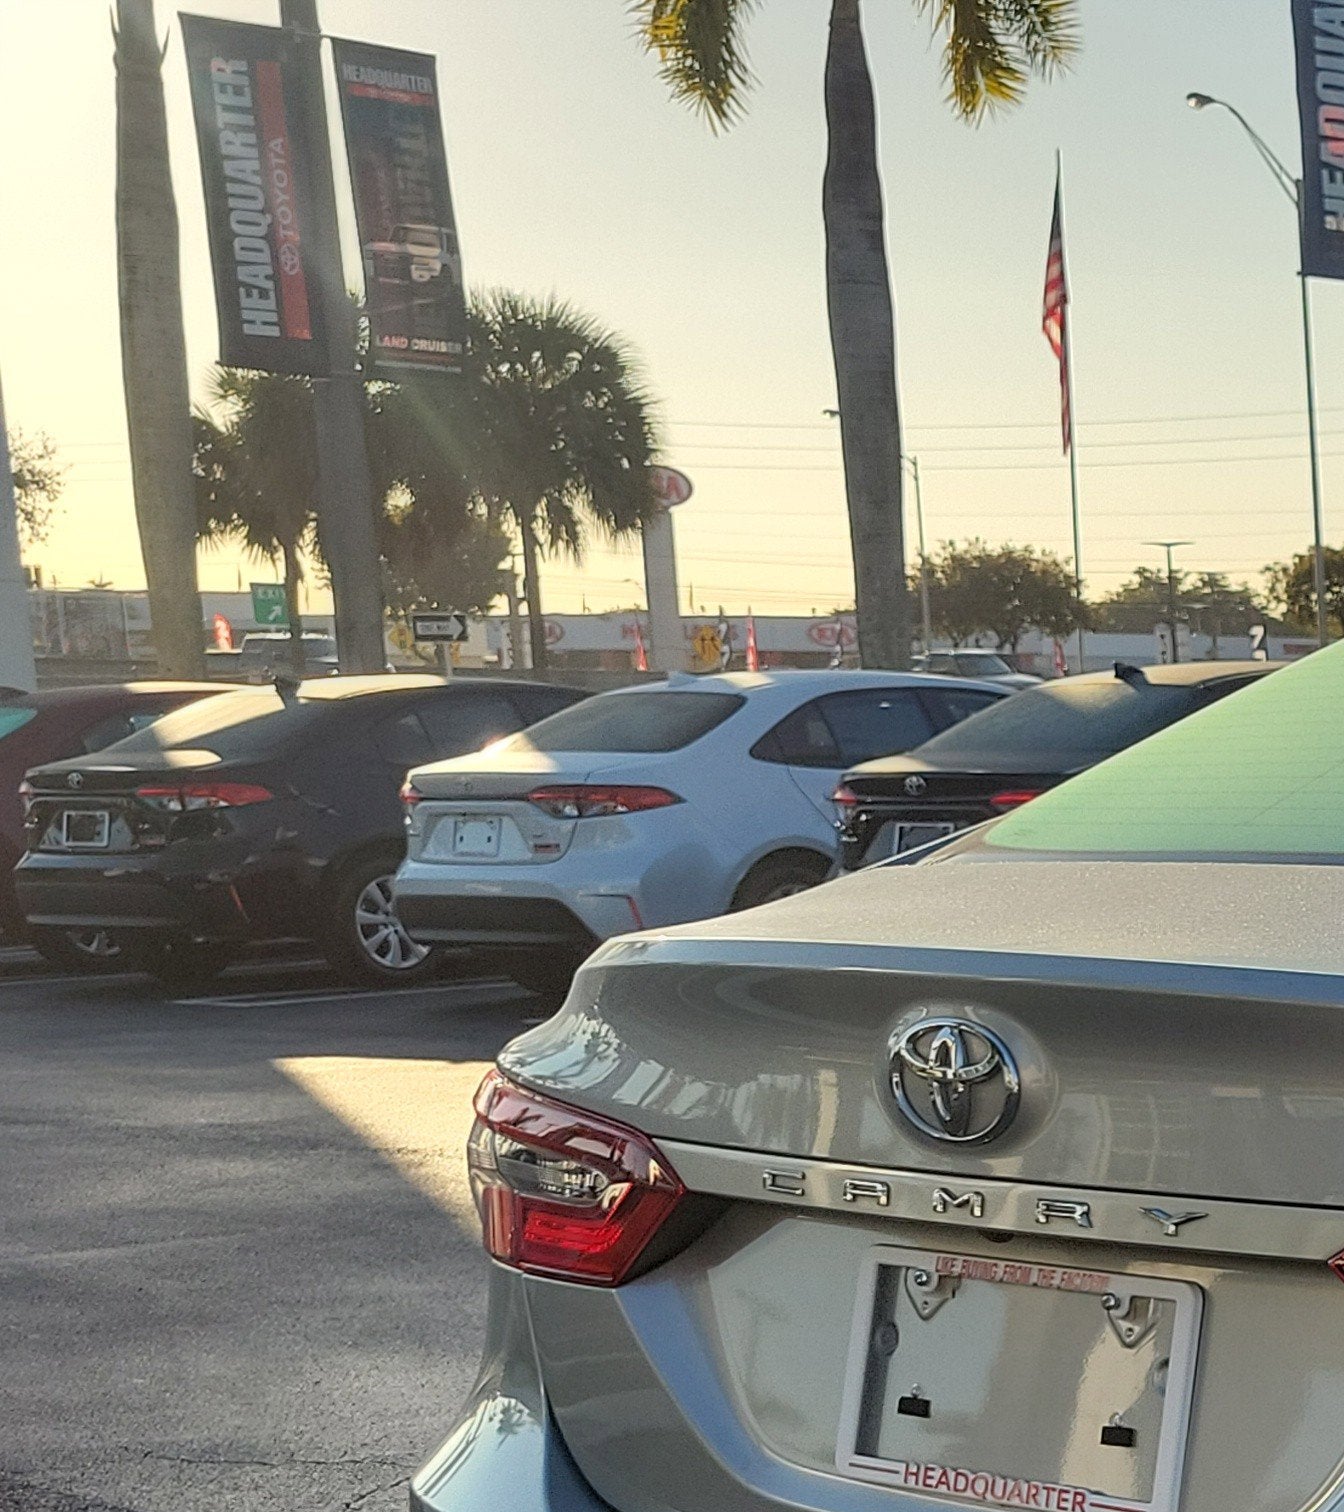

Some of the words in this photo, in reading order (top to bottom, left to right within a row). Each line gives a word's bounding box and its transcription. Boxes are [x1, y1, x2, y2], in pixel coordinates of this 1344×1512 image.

[210, 57, 282, 338] HEADQUARTER
[267, 137, 295, 239] TOYOTA
[376, 334, 409, 350] LAND
[410, 337, 463, 355] CRUISER
[763, 1168, 1209, 1238] CAMRY
[935, 1255, 957, 1273] LIKE
[961, 1258, 998, 1281] BUYING
[1002, 1263, 1032, 1285] FROM
[1037, 1267, 1057, 1288] THE
